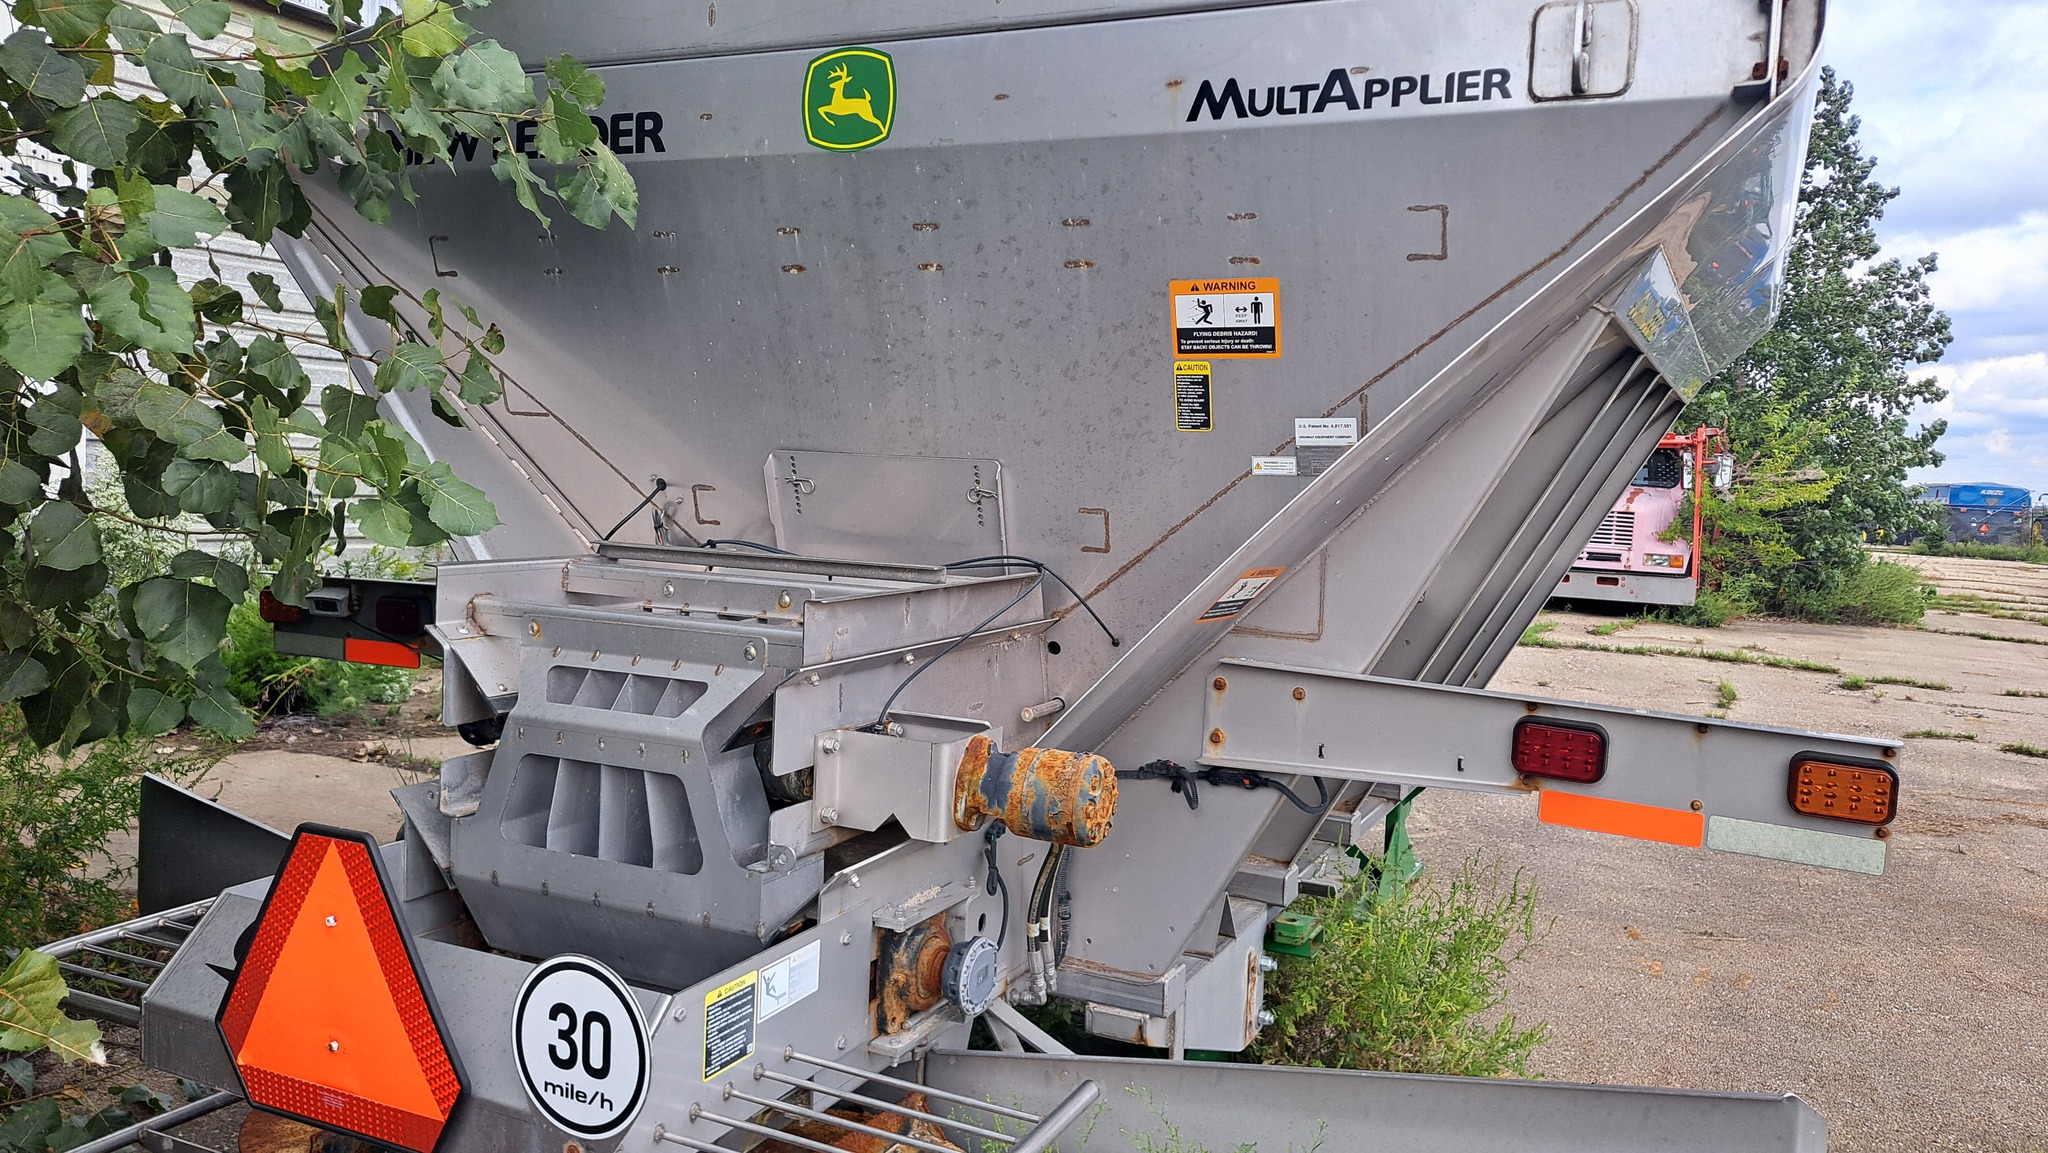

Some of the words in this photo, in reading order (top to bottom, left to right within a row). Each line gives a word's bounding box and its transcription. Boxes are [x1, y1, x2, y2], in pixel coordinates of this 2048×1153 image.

[1203, 281, 1256, 291] WARNING
[724, 979, 747, 995] CAUTION
[548, 1002, 612, 1081] 30
[544, 1080, 614, 1112] mile/h
